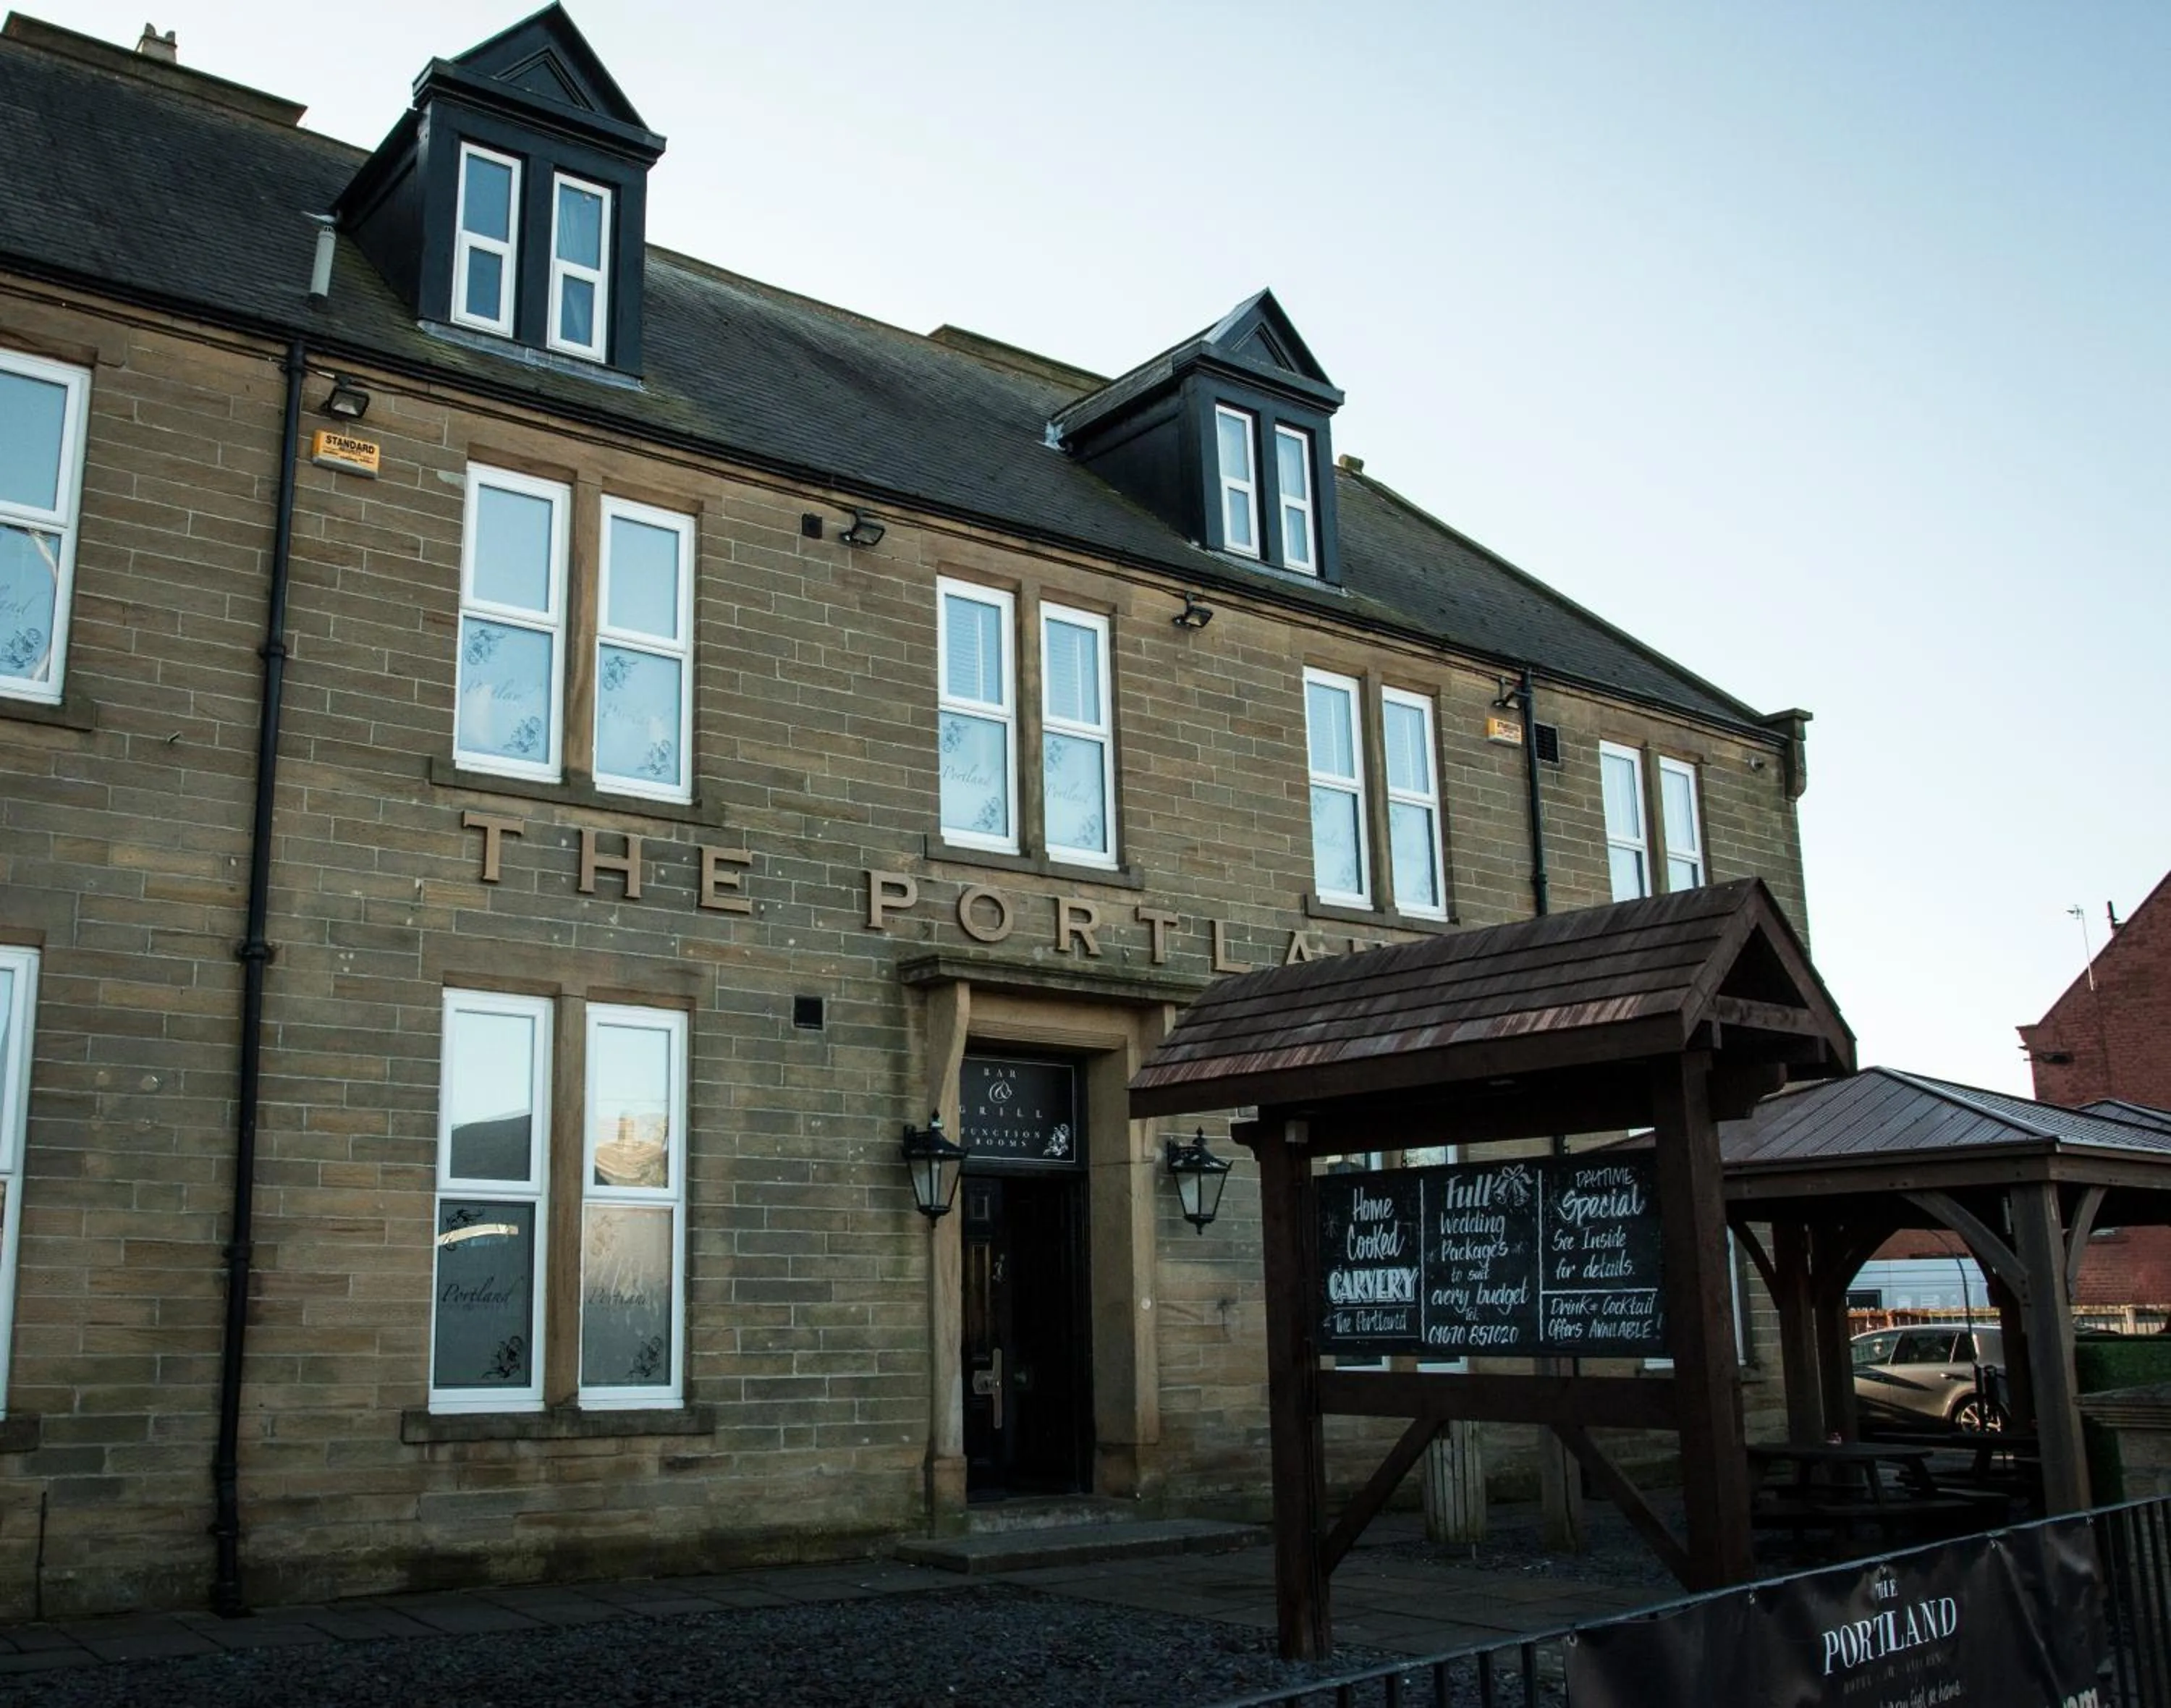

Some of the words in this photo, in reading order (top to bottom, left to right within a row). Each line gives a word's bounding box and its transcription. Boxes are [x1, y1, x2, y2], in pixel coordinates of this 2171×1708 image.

[325, 434, 376, 455] STANDARD
[462, 810, 753, 914] THE
[866, 871, 1391, 973] PORTLA
[1353, 1186, 1395, 1222] Home
[1446, 1173, 1494, 1209] Full
[1557, 1183, 1646, 1226] Special
[1440, 1209, 1506, 1244] Wedding
[1552, 1228, 1575, 1251] See
[1582, 1225, 1627, 1250] Inside
[1441, 1235, 1509, 1270] Packages
[1329, 1267, 1419, 1304] CARVERY
[1476, 1276, 1531, 1315] budget
[1875, 1578, 1898, 1599] THE
[1821, 1597, 1957, 1676] PORTLAND
